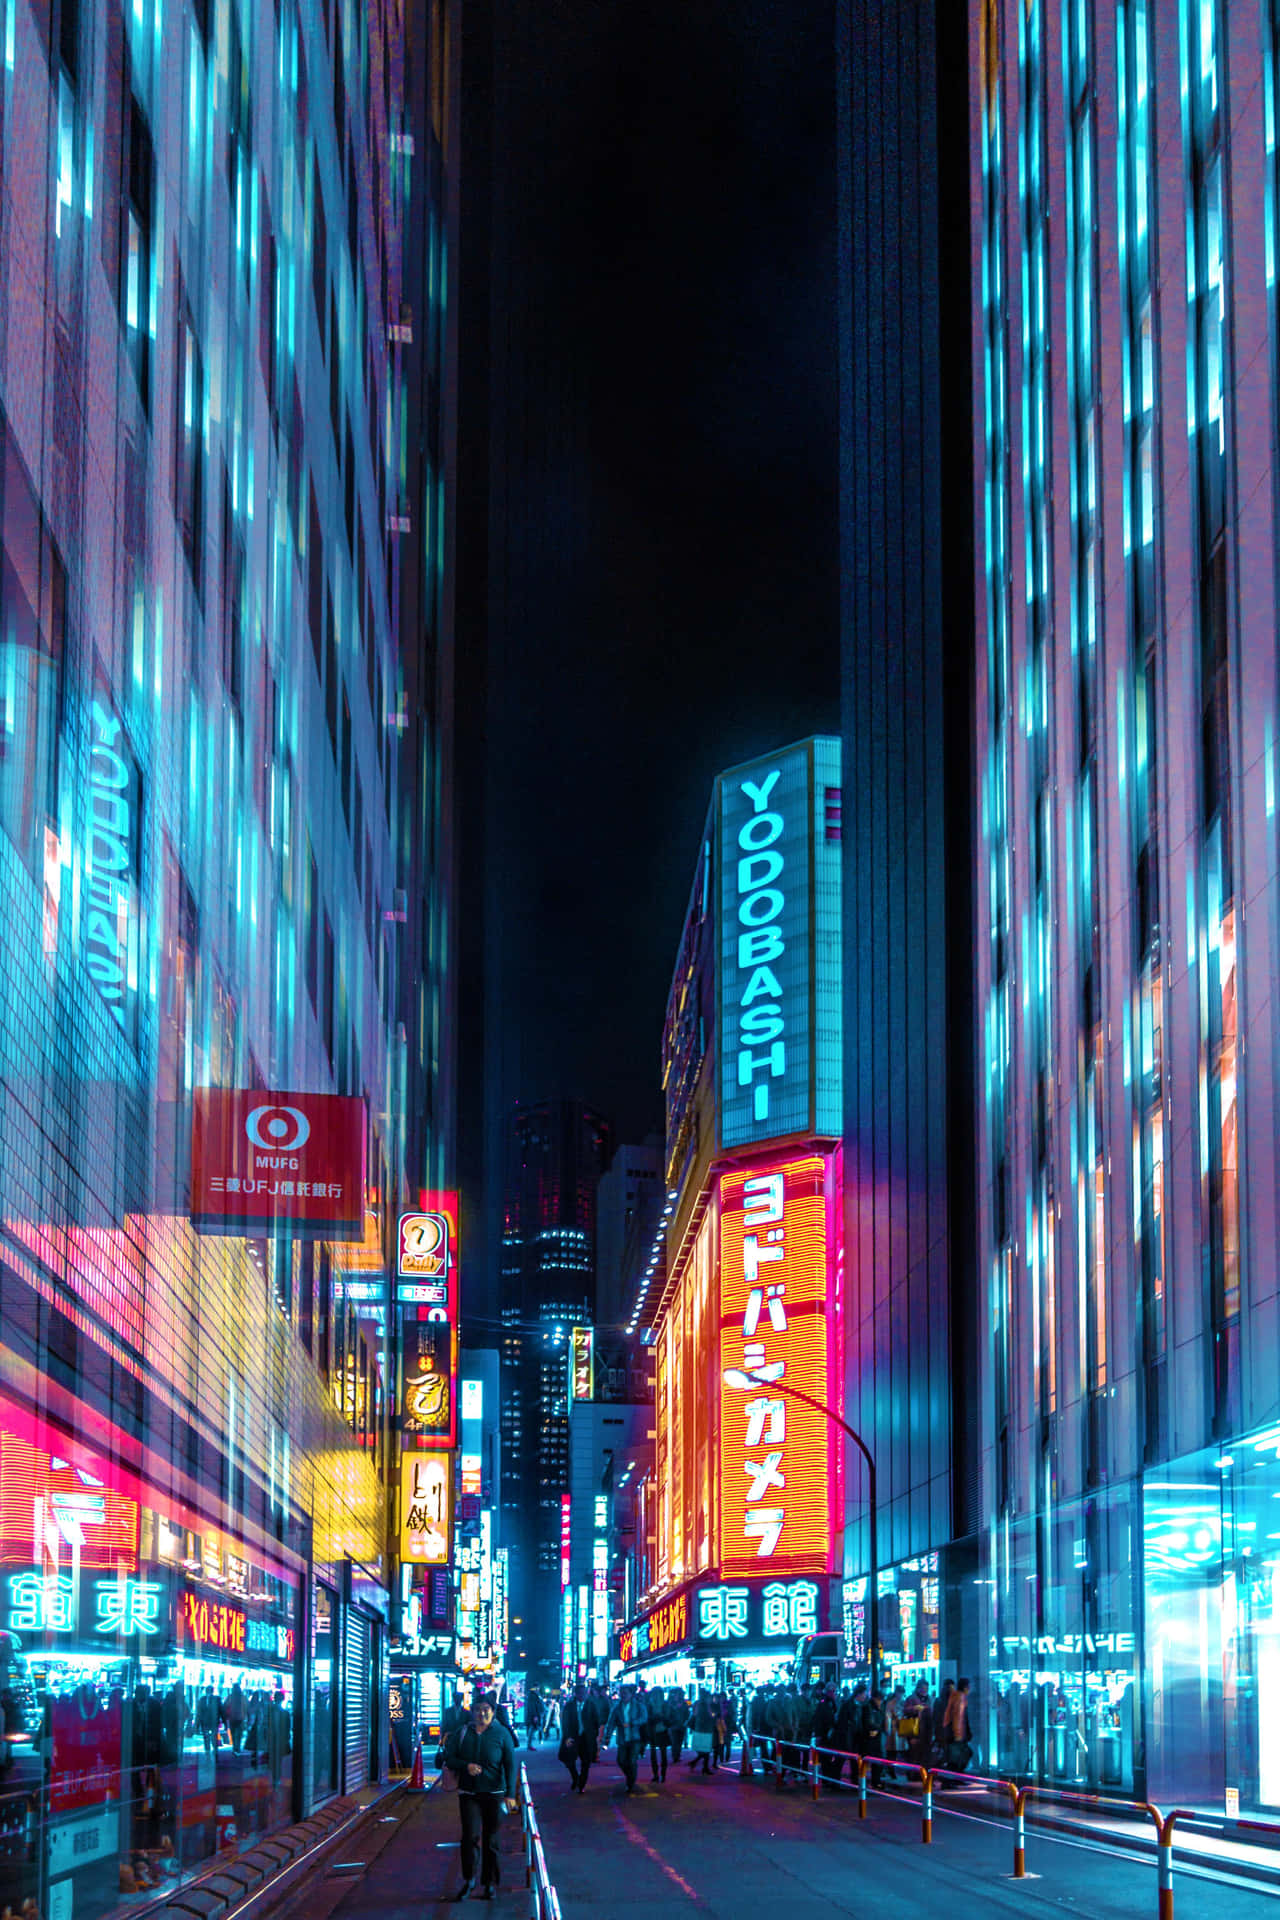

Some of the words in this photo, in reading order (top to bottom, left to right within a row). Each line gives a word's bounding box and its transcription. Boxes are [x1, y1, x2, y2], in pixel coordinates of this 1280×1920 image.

[738, 770, 785, 1121] YODOBASHI
[209, 1176, 343, 1199] 三菱UFJ信託銀行
[255, 1155, 299, 1171] MUFG
[402, 1254, 443, 1273] Daily
[575, 1334, 590, 1394] カラオケ
[743, 1173, 788, 1557] ヨドバシカメラ
[698, 1579, 819, 1641] 東館
